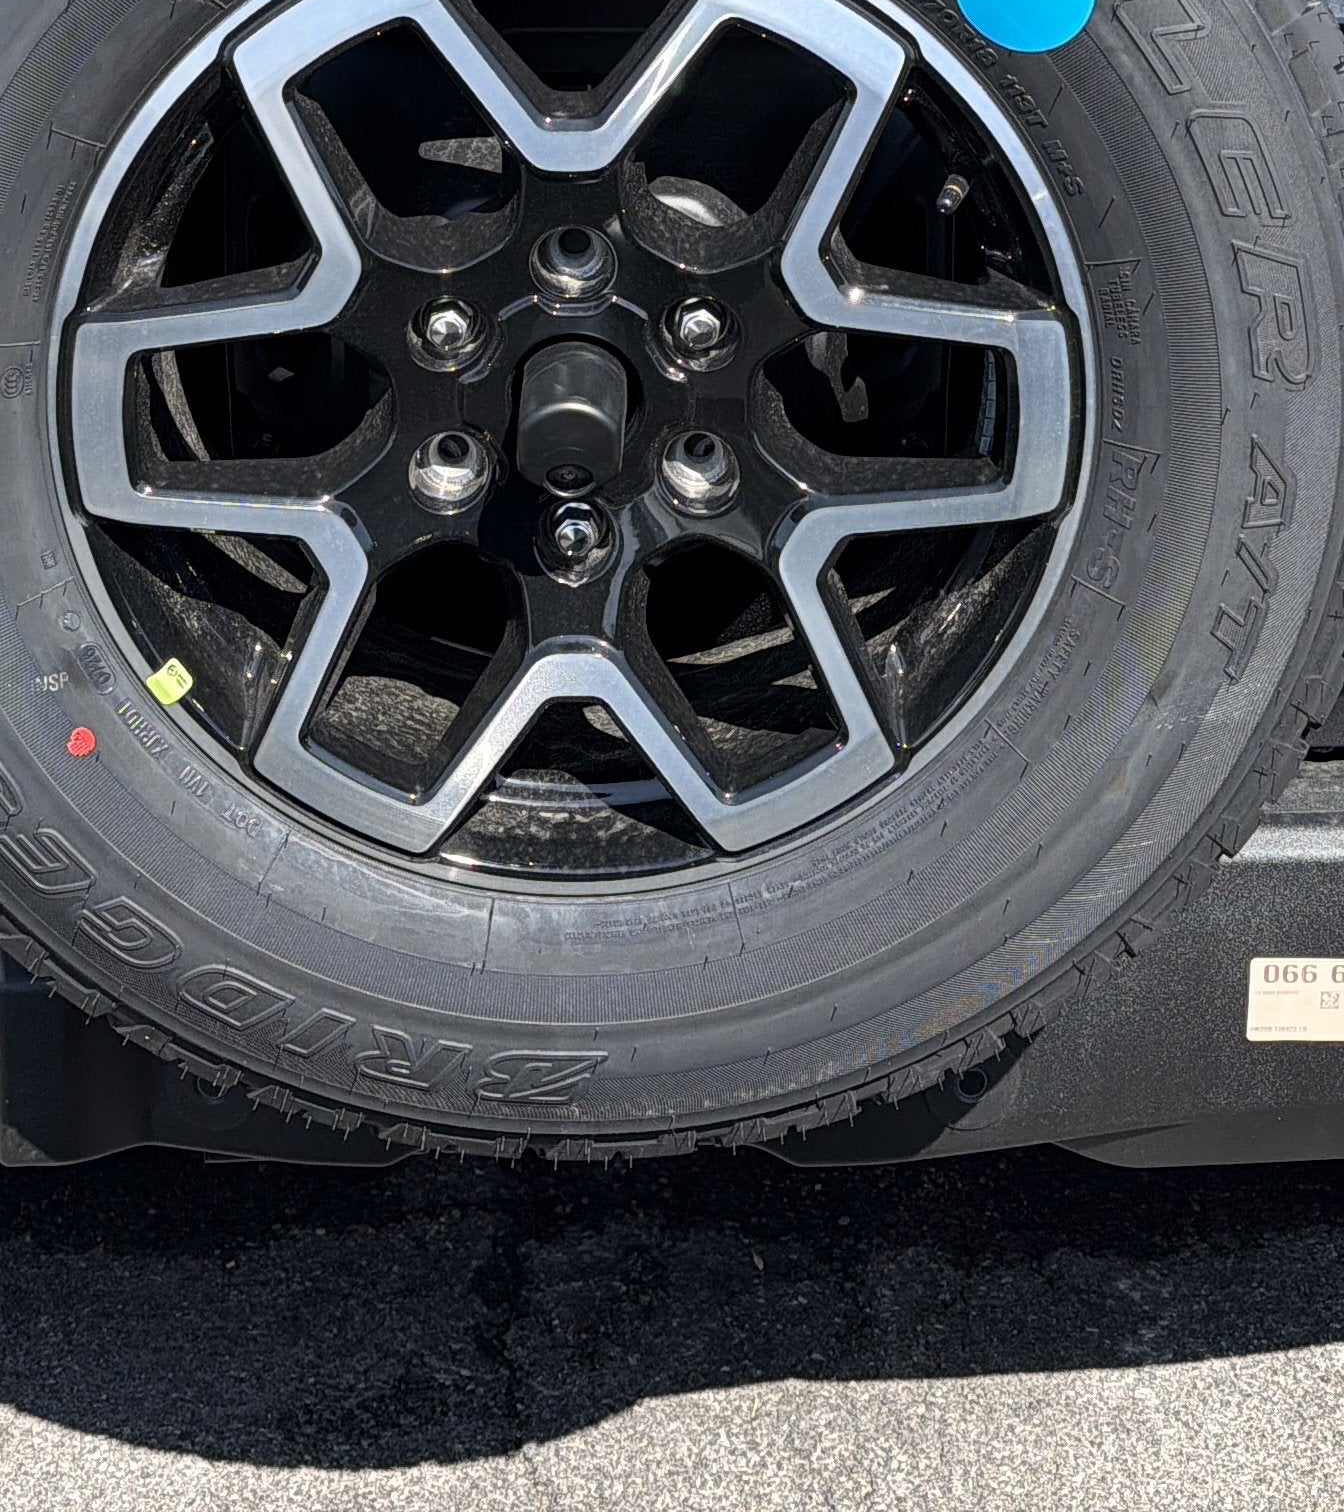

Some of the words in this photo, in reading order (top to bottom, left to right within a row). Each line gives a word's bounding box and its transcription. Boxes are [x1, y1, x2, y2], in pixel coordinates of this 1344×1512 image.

[1043, 138, 1085, 197] M+S
[1099, 288, 1114, 329] RADIAL
[1108, 277, 1130, 339] TUBELESS
[1086, 450, 1142, 589] RH-S
[1209, 434, 1302, 687] A/T
[221, 802, 264, 839] DOT
[1263, 964, 1318, 984] 066
